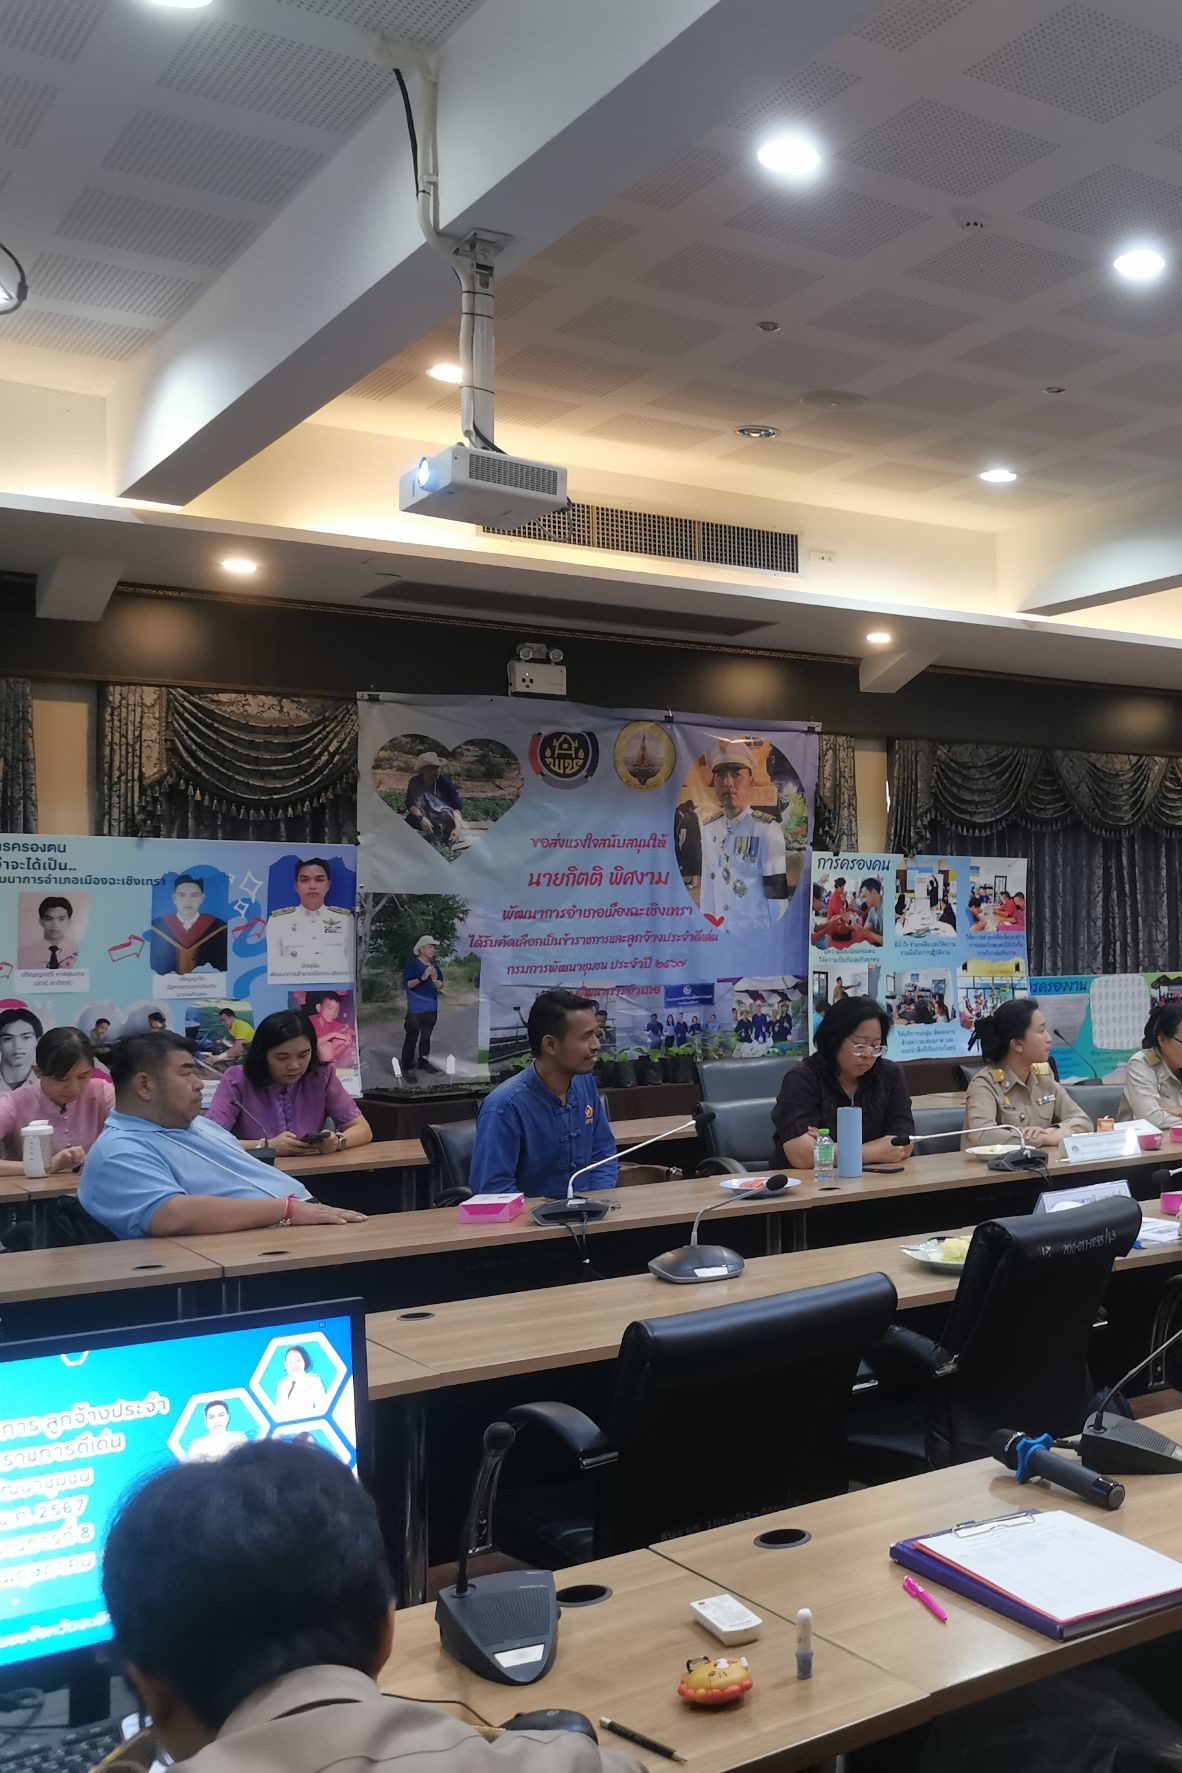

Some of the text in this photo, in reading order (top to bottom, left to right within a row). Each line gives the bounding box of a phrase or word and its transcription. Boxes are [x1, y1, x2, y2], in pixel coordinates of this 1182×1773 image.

[0, 842, 67, 854] รครองตน
[530, 833, 668, 854] ขอส่งแรงใจสนับสนุนให้
[817, 857, 890, 872] การครองคน
[528, 865, 670, 887] นายกิตติ พิศงาม
[502, 902, 693, 921] พัฒนาการอำเภอเมืองฉะเชิงเทรา
[467, 928, 719, 949] ได้รับคัดเลือกเป็นข้าราชการและลูกจ้างประจำดีเด่น
[506, 956, 688, 976] กรมการพัฒนาชุมชน ประจำปี ๒๕๖๗
[46, 1394, 168, 1436] ลูกจ้างประจำ
[40, 1498, 85, 1519] 2567
